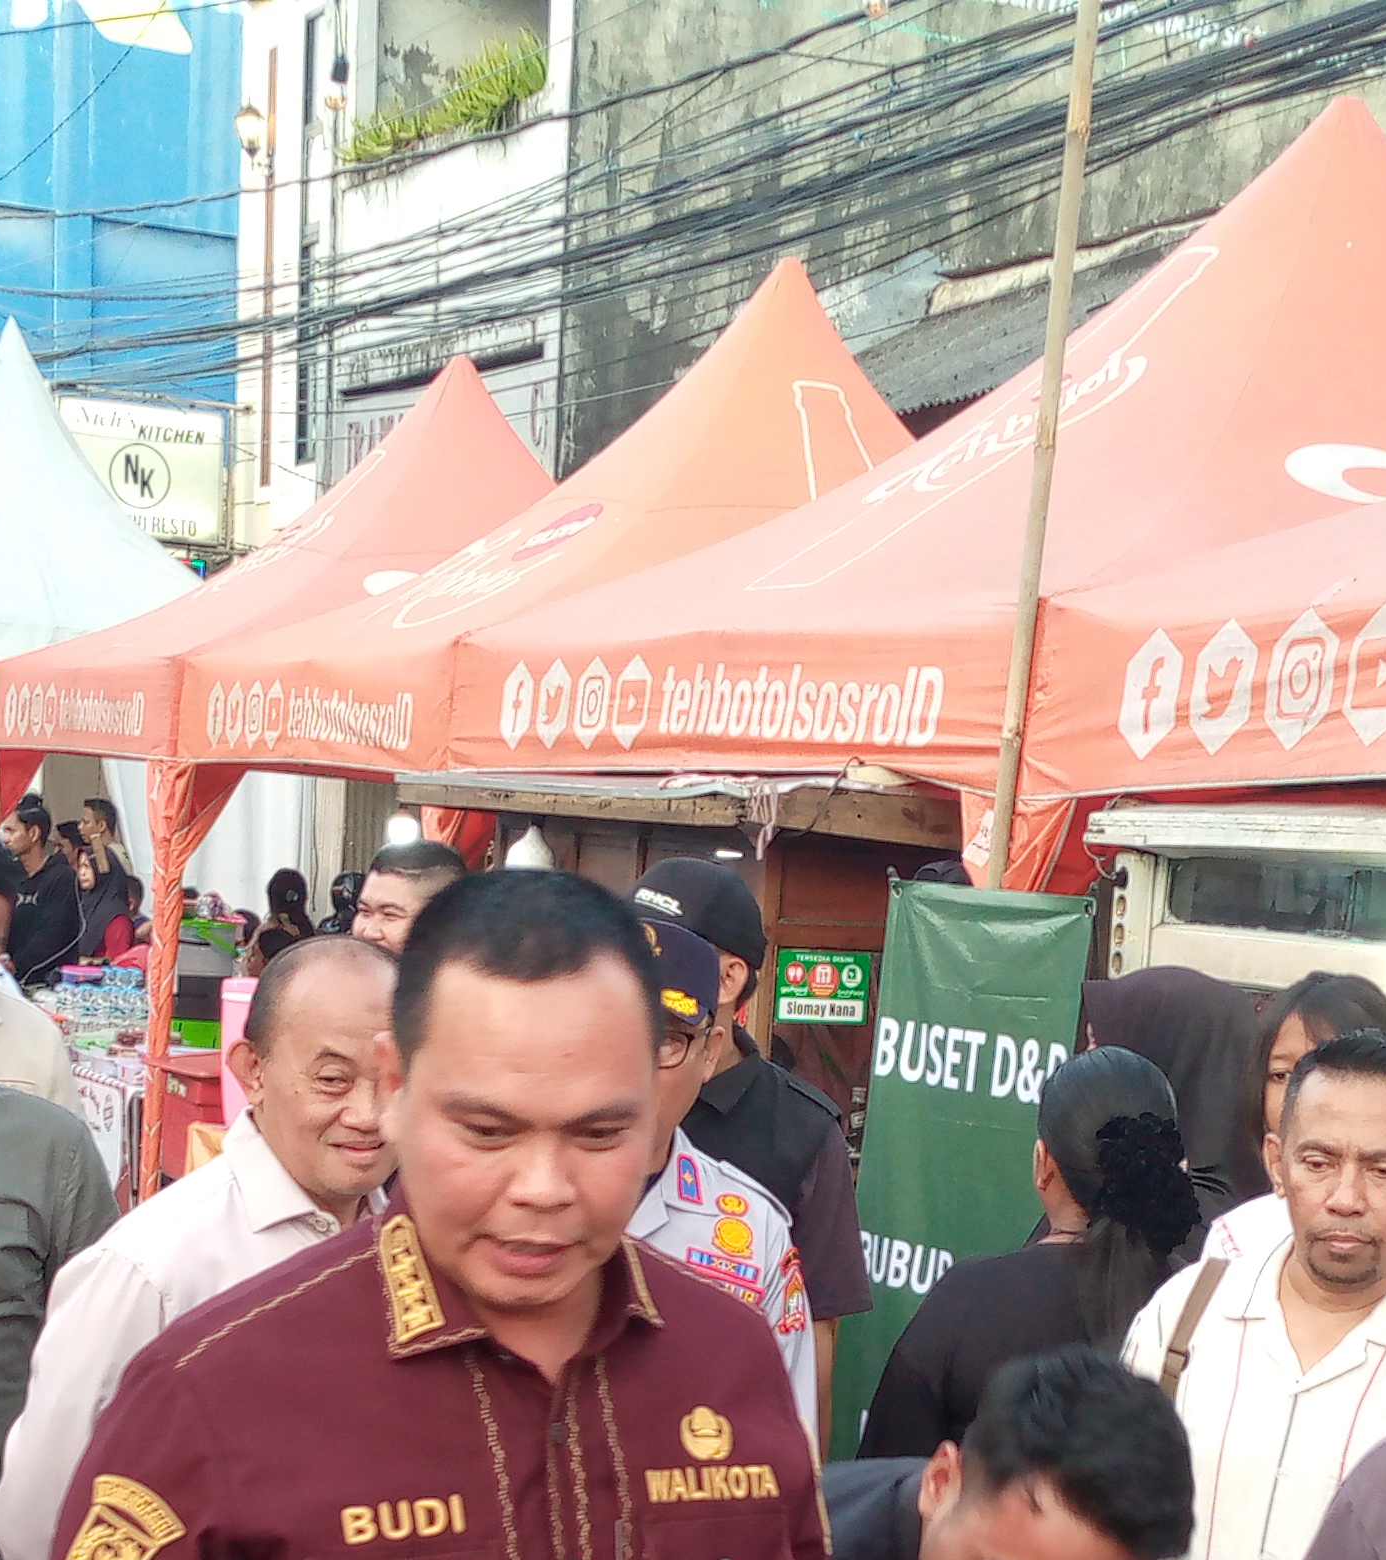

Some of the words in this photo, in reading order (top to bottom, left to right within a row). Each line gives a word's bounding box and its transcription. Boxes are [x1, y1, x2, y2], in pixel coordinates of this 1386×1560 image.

[138, 425, 205, 445] KITCHEN
[287, 685, 413, 752] tehbotolsosroID
[661, 661, 945, 747] tehbotolsosroID
[829, 1003, 856, 1017] Nana
[874, 1016, 987, 1094] BUSET
[644, 1463, 781, 1502] WALIKOTA
[339, 1493, 469, 1546] BUDI
